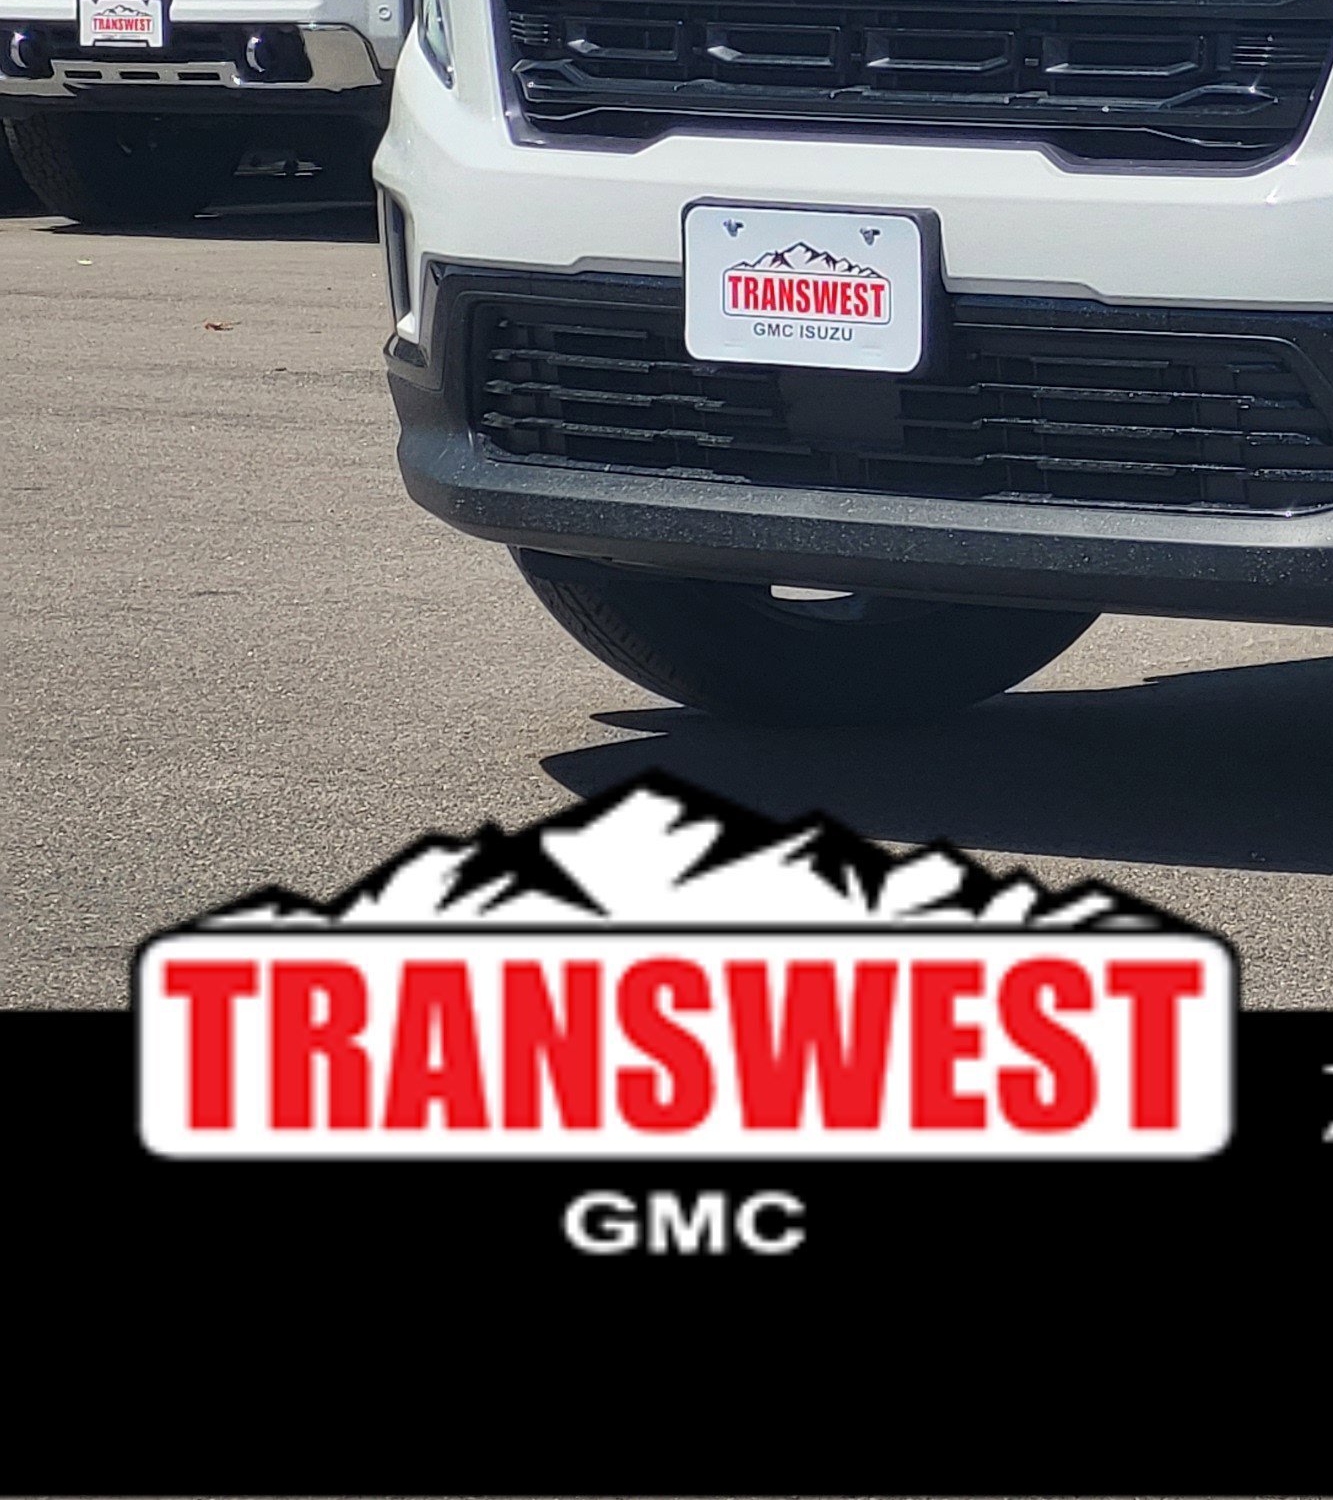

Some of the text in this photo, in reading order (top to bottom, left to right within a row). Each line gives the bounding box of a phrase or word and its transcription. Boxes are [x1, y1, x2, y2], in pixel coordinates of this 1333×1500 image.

[93, 18, 152, 32] TRANSWEST
[728, 275, 885, 318] TRANSWEST
[753, 322, 853, 341] GMC ISUZU
